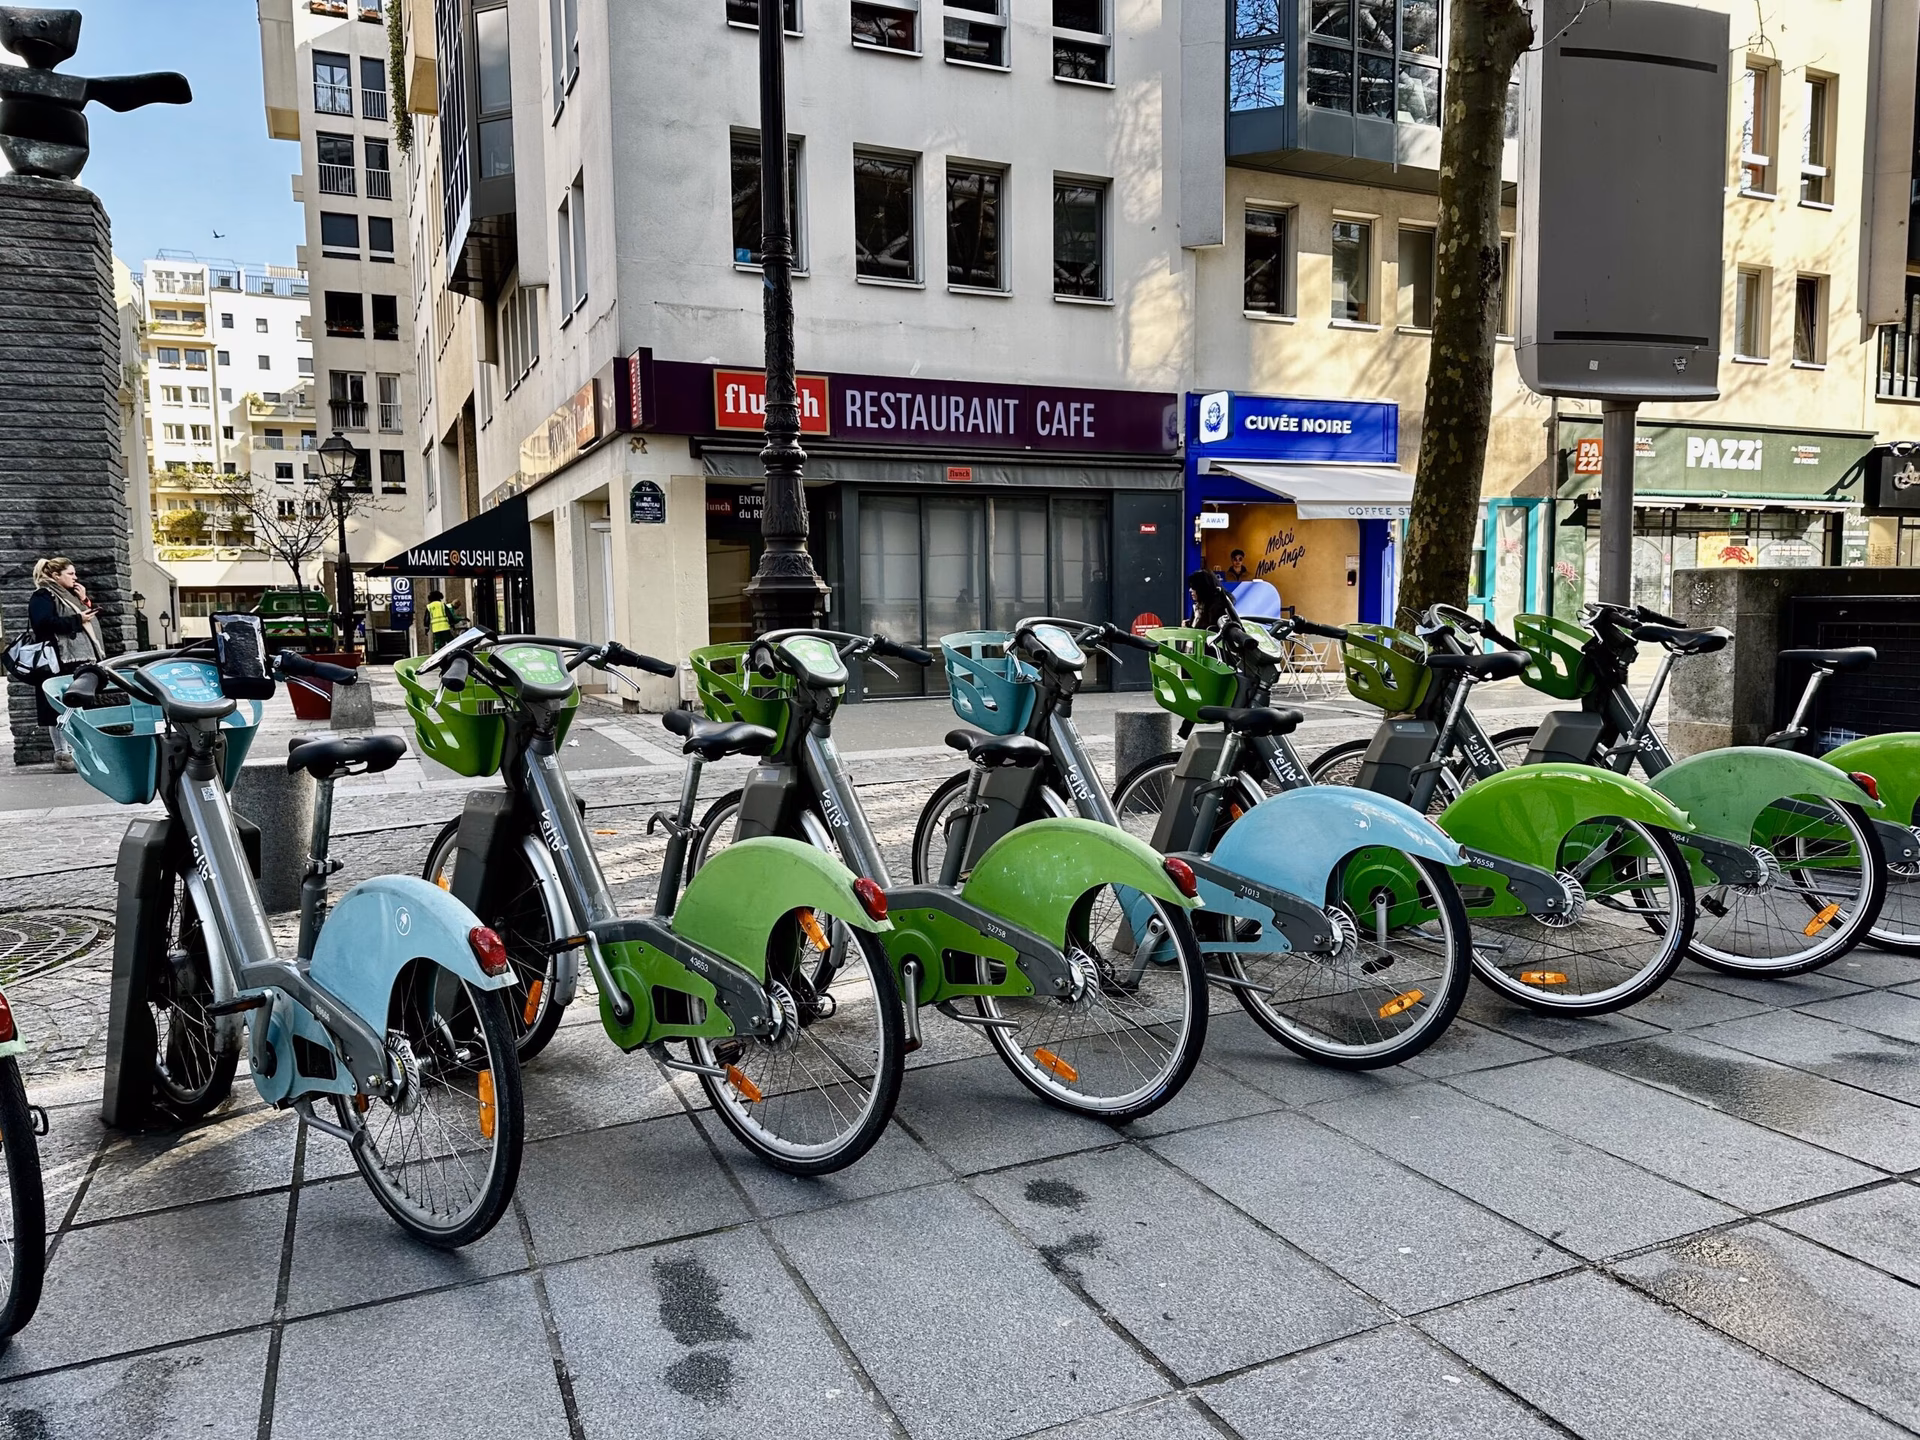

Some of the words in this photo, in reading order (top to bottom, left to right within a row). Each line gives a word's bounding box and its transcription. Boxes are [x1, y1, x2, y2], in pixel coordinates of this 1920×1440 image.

[725, 383, 820, 417] fluh
[845, 389, 1019, 434] RESTAURANT
[1036, 400, 1095, 438] CAFE
[1244, 414, 1299, 432] CUVÉE
[1301, 418, 1352, 434] NOIRE
[1581, 442, 1599, 457] PA
[949, 469, 970, 477] flunch
[706, 502, 731, 512] lunch
[738, 495, 766, 505] ENTR
[738, 509, 749, 519] du
[1347, 507, 1393, 516] COFFEE
[1398, 507, 1412, 516] ST
[1265, 527, 1295, 556] Merci
[407, 549, 495, 567] MAMIE@SUSHI
[498, 550, 525, 567] BAR
[1254, 558, 1277, 579] Mon
[1278, 545, 1306, 569] Ange
[1472, 856, 1495, 869] 76558
[1239, 884, 1260, 899] 71013
[986, 922, 1006, 939] 52758
